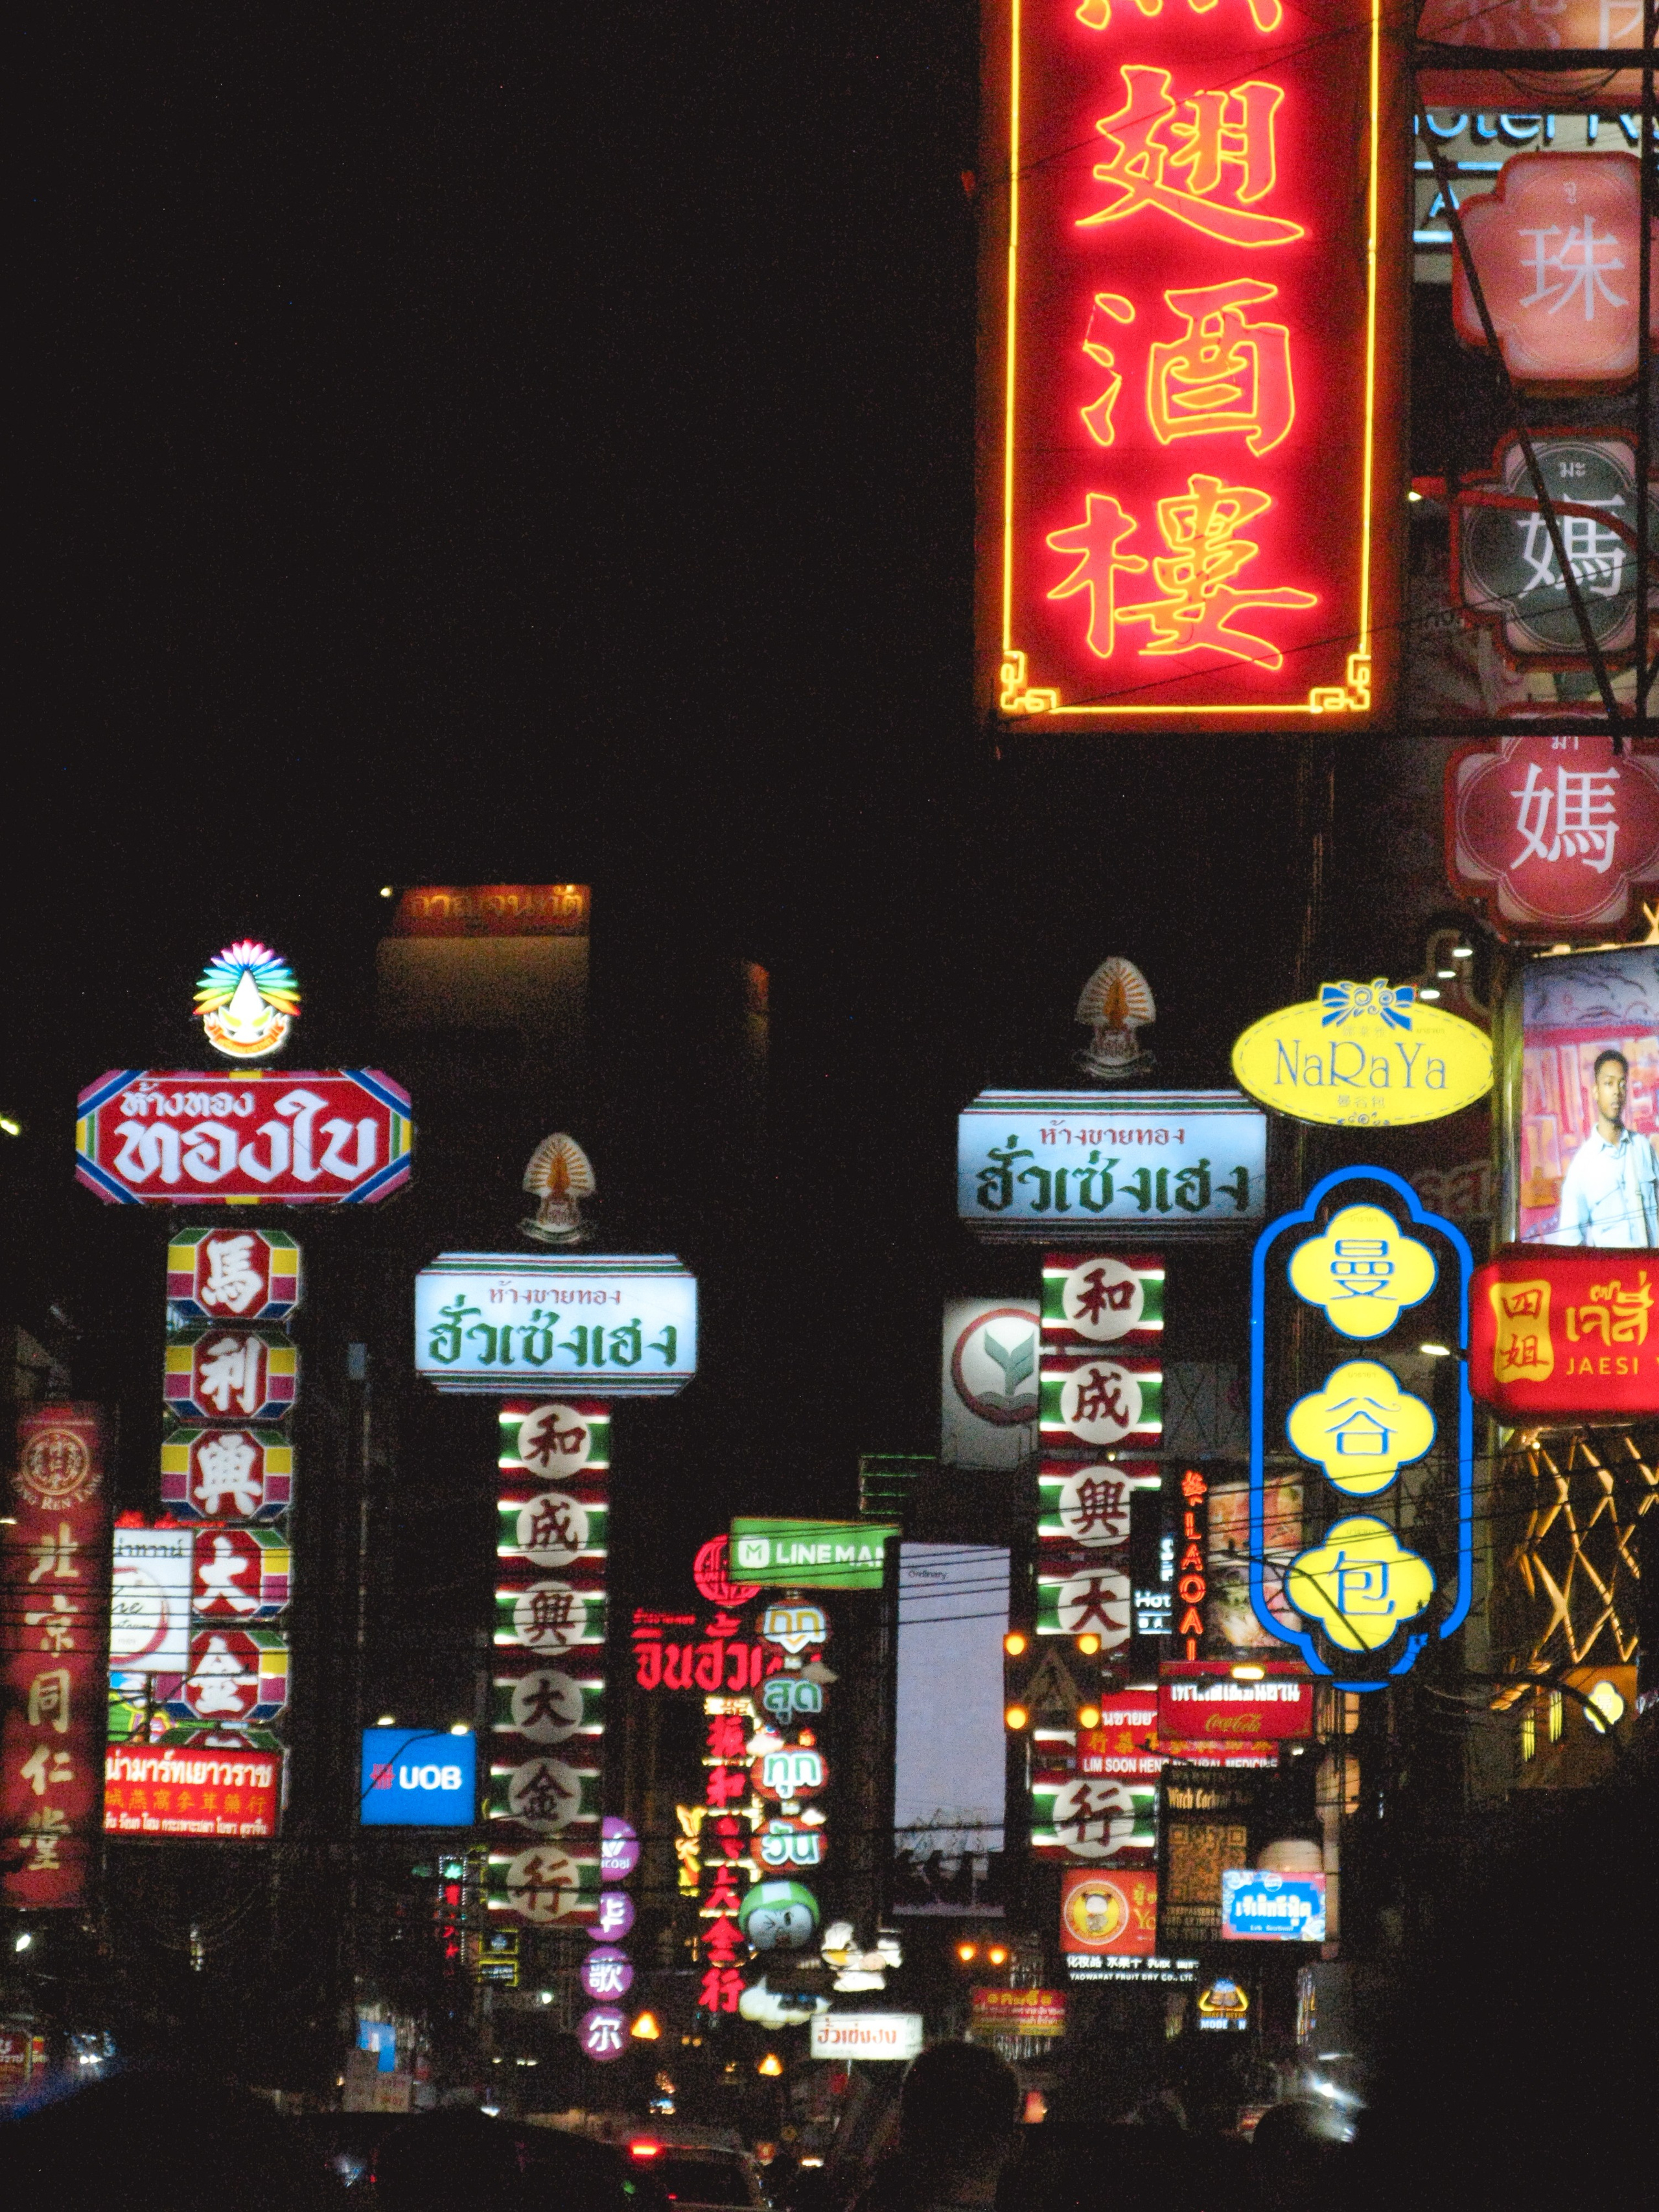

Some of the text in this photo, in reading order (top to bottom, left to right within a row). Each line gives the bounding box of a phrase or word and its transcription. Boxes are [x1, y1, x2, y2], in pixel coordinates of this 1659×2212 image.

[1043, 0, 1319, 671] 翅酒樓
[1275, 1038, 1448, 1090] NaRaYa
[114, 1089, 379, 1183] ทองใบ
[1039, 1119, 1186, 1145] ห้างขายทอง
[489, 1280, 621, 1306] ห้างขายทอง
[1500, 1289, 1549, 1371] 四姐
[1566, 1356, 1639, 1375] JAESI
[776, 1543, 832, 1564] LINE
[1178, 1511, 1207, 1661] LAOAI
[399, 1765, 462, 1791] UOB
[1083, 1758, 1102, 1773] LIM
[1104, 1758, 1137, 1773] SOON
[763, 1822, 818, 1864] วัน
